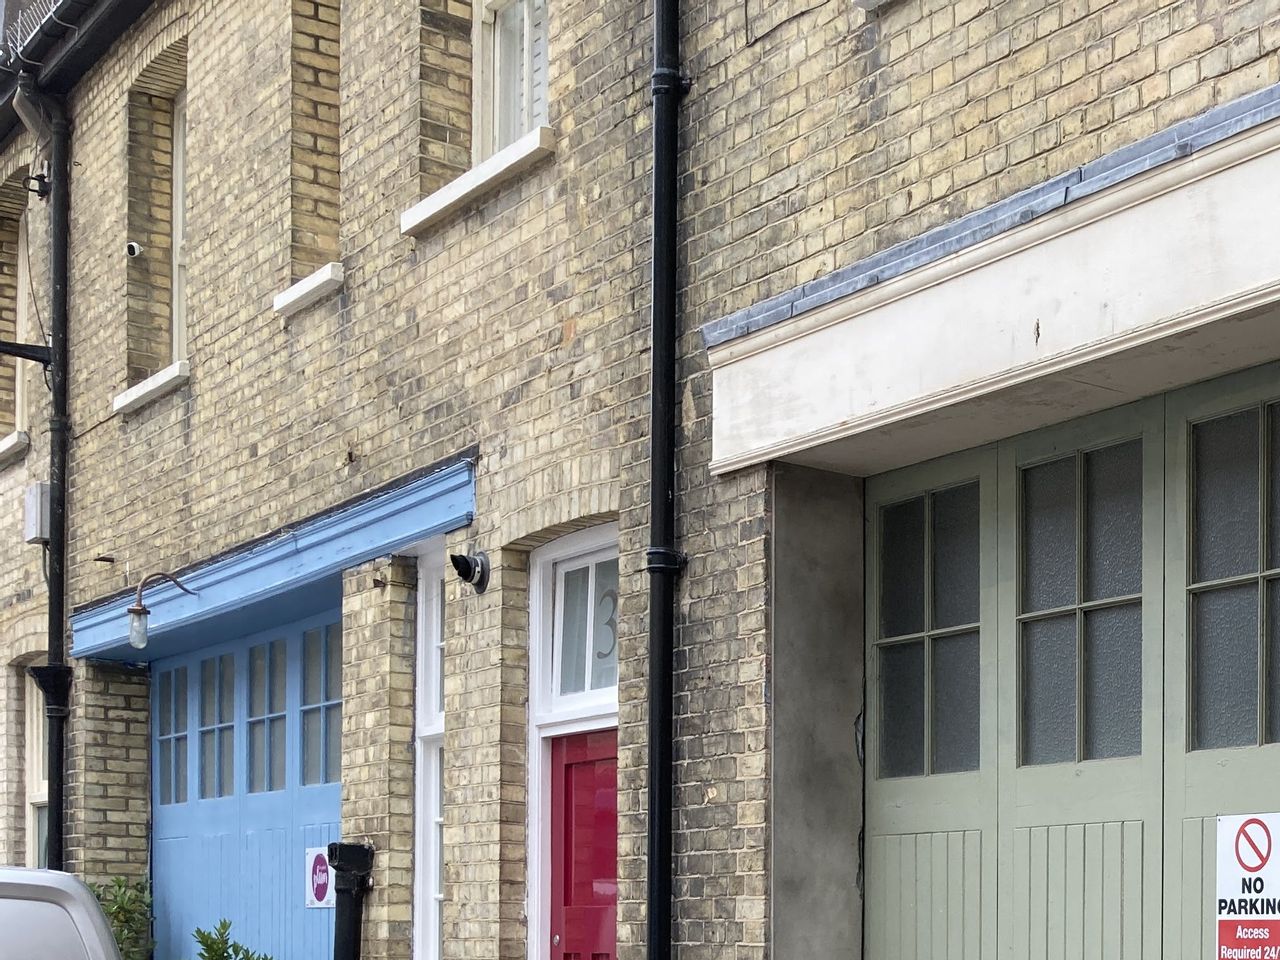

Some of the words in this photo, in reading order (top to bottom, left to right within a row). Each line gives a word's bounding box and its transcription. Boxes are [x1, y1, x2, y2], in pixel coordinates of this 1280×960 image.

[597, 589, 617, 659] 3
[1241, 877, 1264, 894] NO
[1236, 925, 1269, 939] Access
[1220, 945, 1261, 960] Required
